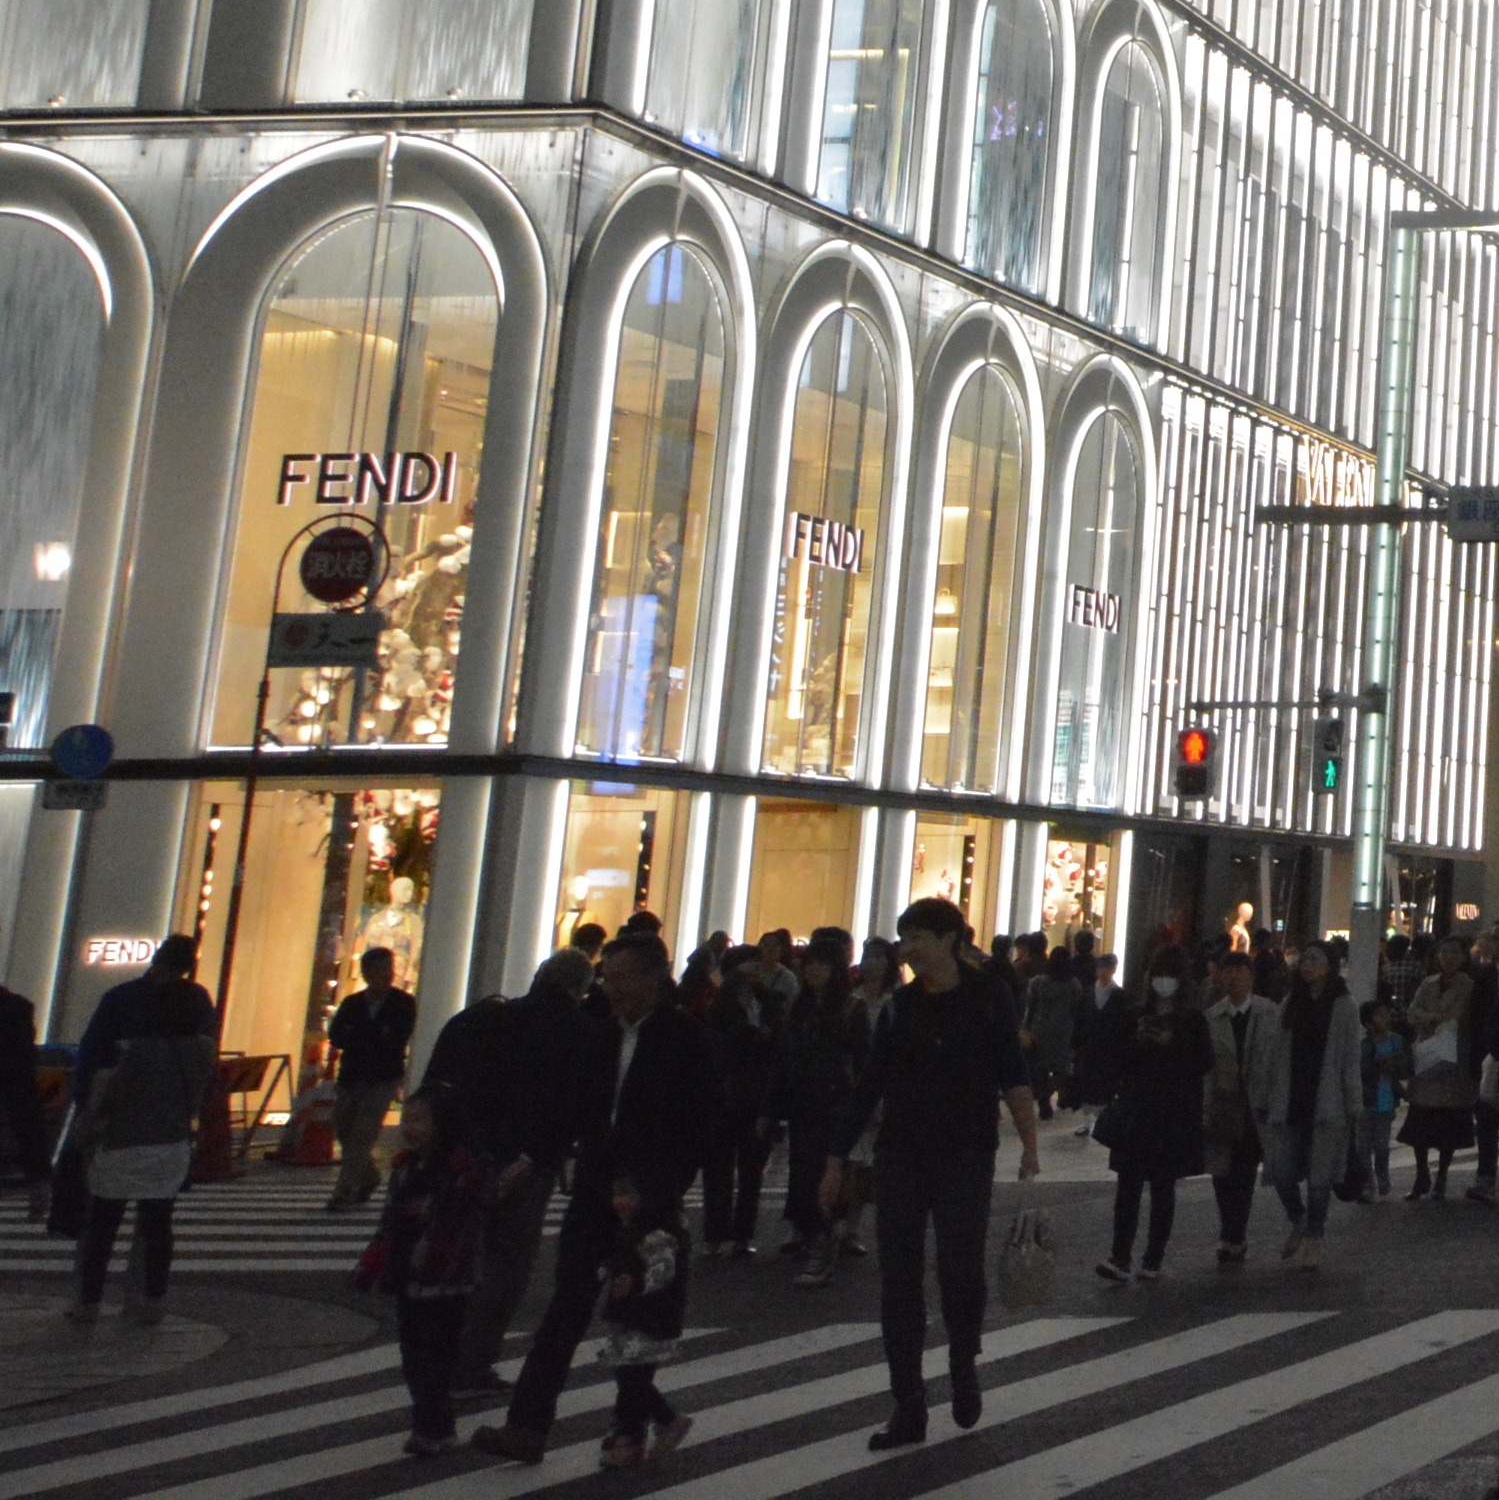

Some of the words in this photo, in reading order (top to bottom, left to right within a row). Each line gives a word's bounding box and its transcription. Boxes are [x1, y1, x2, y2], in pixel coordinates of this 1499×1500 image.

[276, 450, 458, 507] FENDI
[785, 511, 865, 574] FENDI
[1067, 583, 1122, 634] FENDI
[86, 938, 163, 965] FEND
